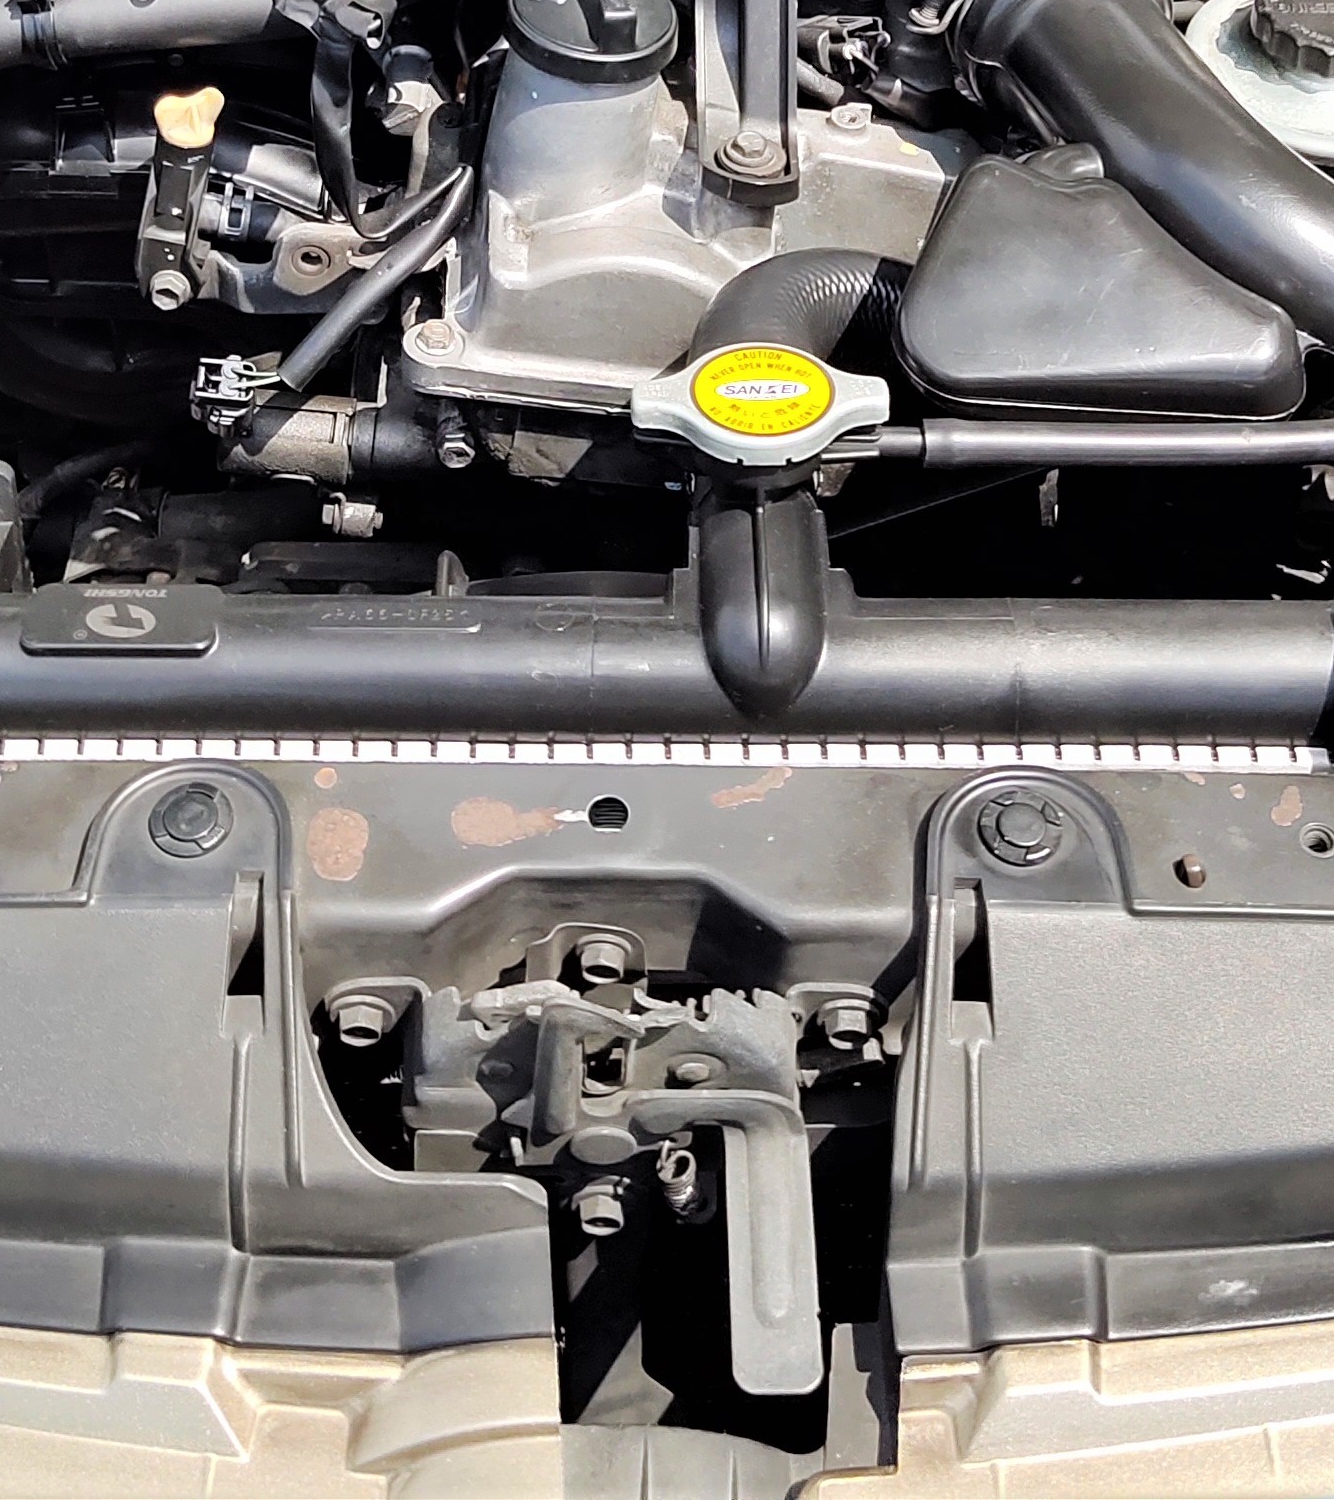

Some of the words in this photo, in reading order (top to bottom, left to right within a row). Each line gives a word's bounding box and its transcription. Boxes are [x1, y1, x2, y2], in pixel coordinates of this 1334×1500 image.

[733, 351, 783, 362] CAUTION
[710, 366, 735, 380] NEVER
[740, 363, 761, 371] OPEN
[767, 363, 793, 372] WHEN
[795, 368, 812, 379] HOT
[709, 406, 721, 416] NO
[83, 589, 168, 598] TONGSHI
